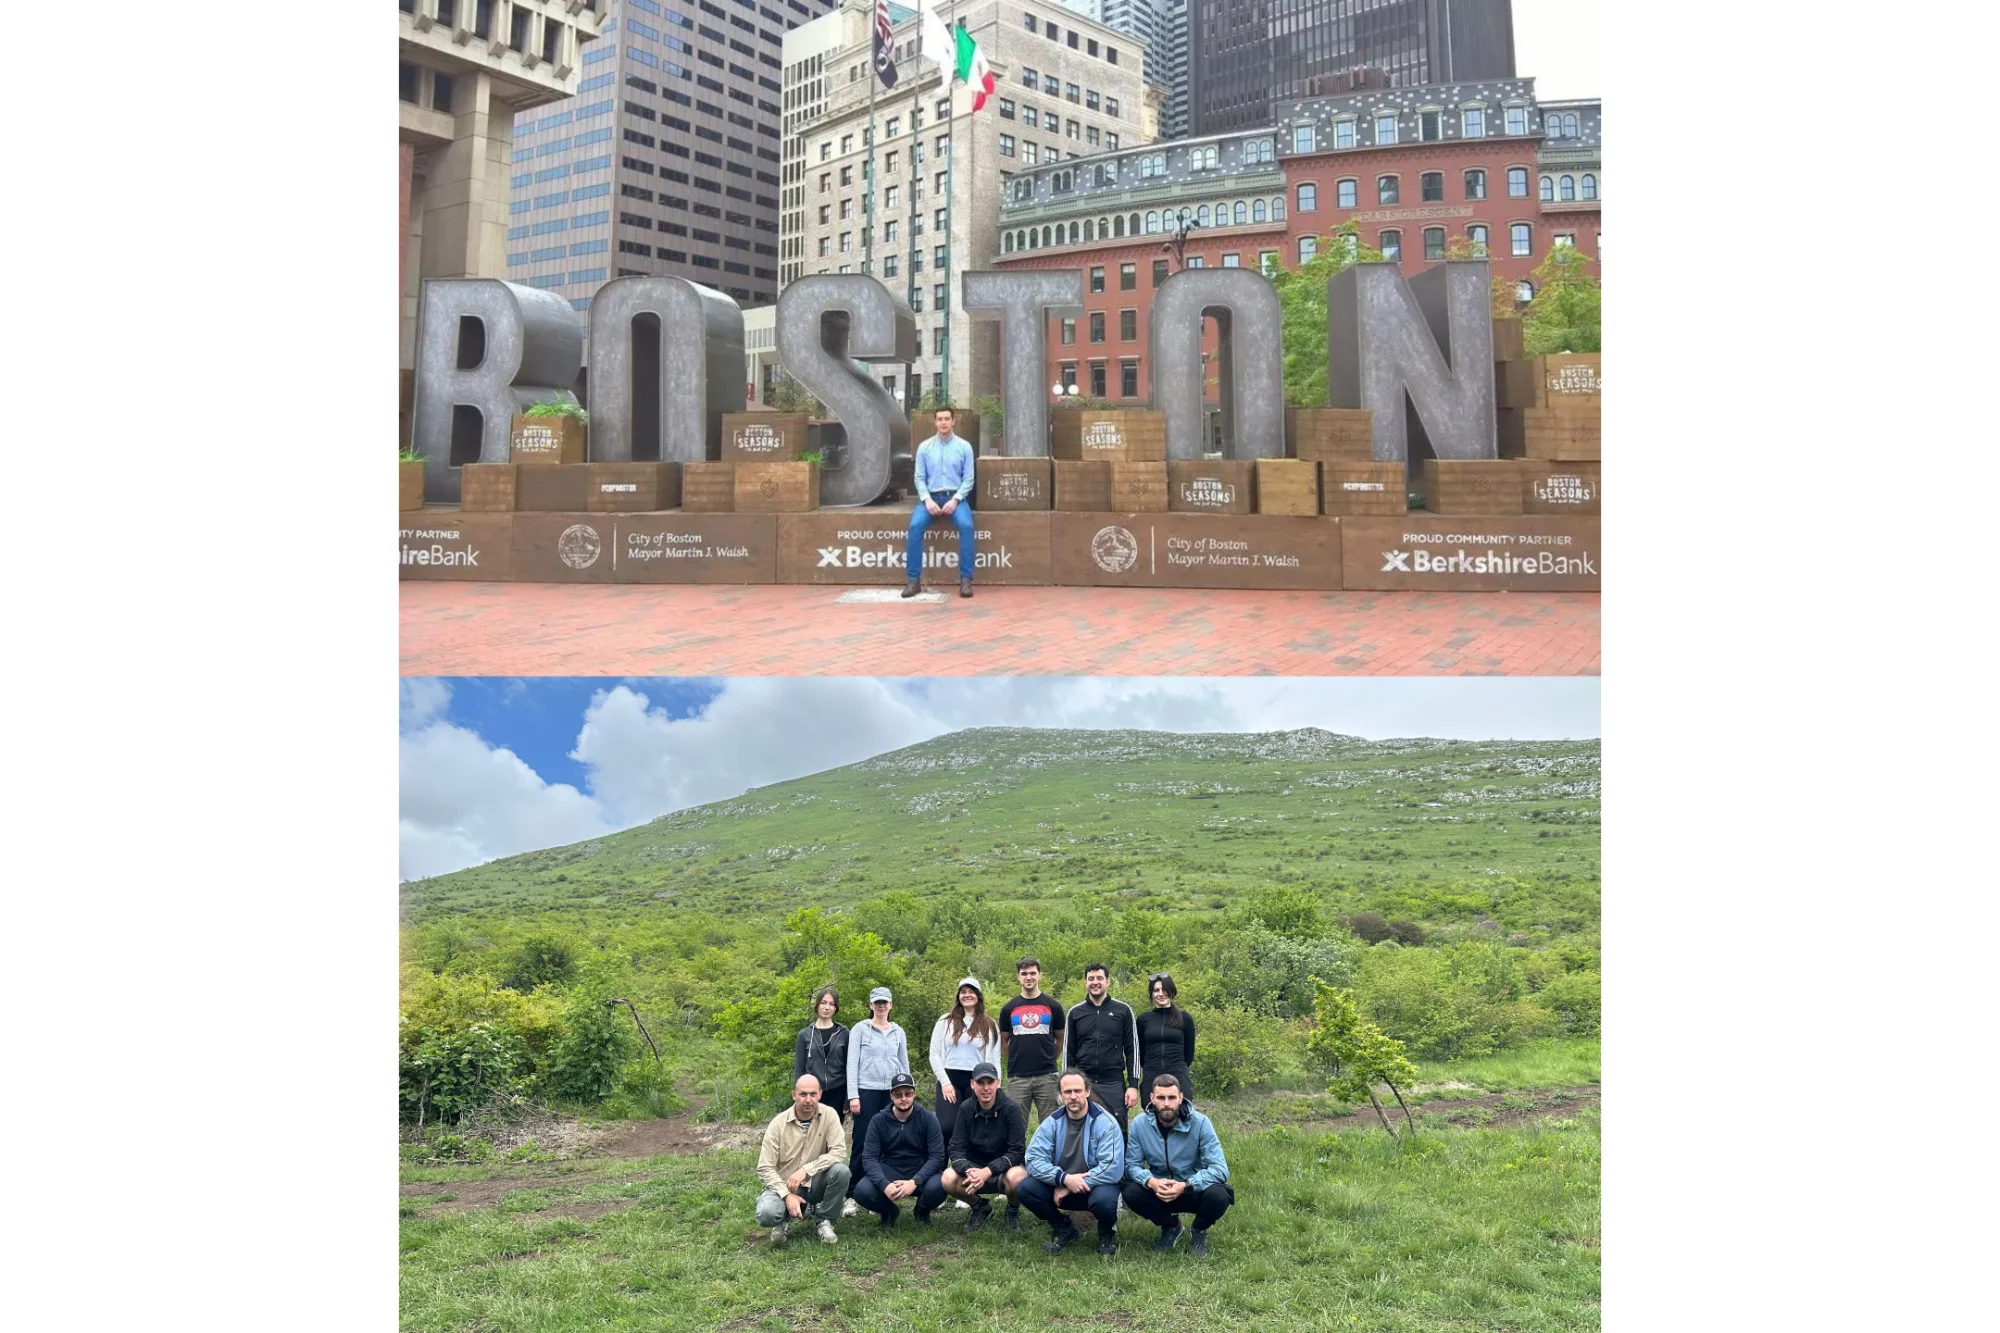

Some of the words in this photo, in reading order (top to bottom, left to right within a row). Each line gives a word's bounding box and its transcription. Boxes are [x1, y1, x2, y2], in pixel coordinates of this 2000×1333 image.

[411, 261, 1498, 508] BOSTON
[515, 437, 559, 449] SEASONS
[737, 437, 780, 448] SEASONS
[1085, 434, 1121, 446] SEASONS
[1193, 481, 1222, 490] BOSTON
[1547, 478, 1581, 487] BOSTON
[1185, 490, 1230, 503] SEASONS
[1540, 487, 1590, 500] SEASONS
[416, 530, 460, 540] PARTNER
[628, 533, 651, 547] City
[653, 533, 666, 547] of
[666, 533, 702, 544] Boston
[837, 530, 874, 540] PROUD
[876, 530, 940, 540] COMMITY
[943, 530, 992, 540] PAER
[1402, 534, 1443, 544] PROUD
[1446, 534, 1517, 545] COMMUNITY
[1519, 535, 1572, 545] PARTNER
[1167, 537, 1192, 551] City
[1194, 538, 1206, 551] of
[1209, 539, 1248, 550] Boston
[399, 544, 480, 567] ireBank
[628, 547, 662, 561] Mayor
[665, 547, 703, 558] Martin
[705, 547, 713, 558] J.
[717, 546, 749, 557] Walsh
[846, 544, 1012, 568] Berksireank
[1167, 553, 1205, 568] Mayor
[1208, 554, 1250, 566] Martin
[1252, 555, 1261, 566] J.
[1263, 555, 1300, 567] Walsh
[1414, 549, 1598, 575] BerkshireBank
